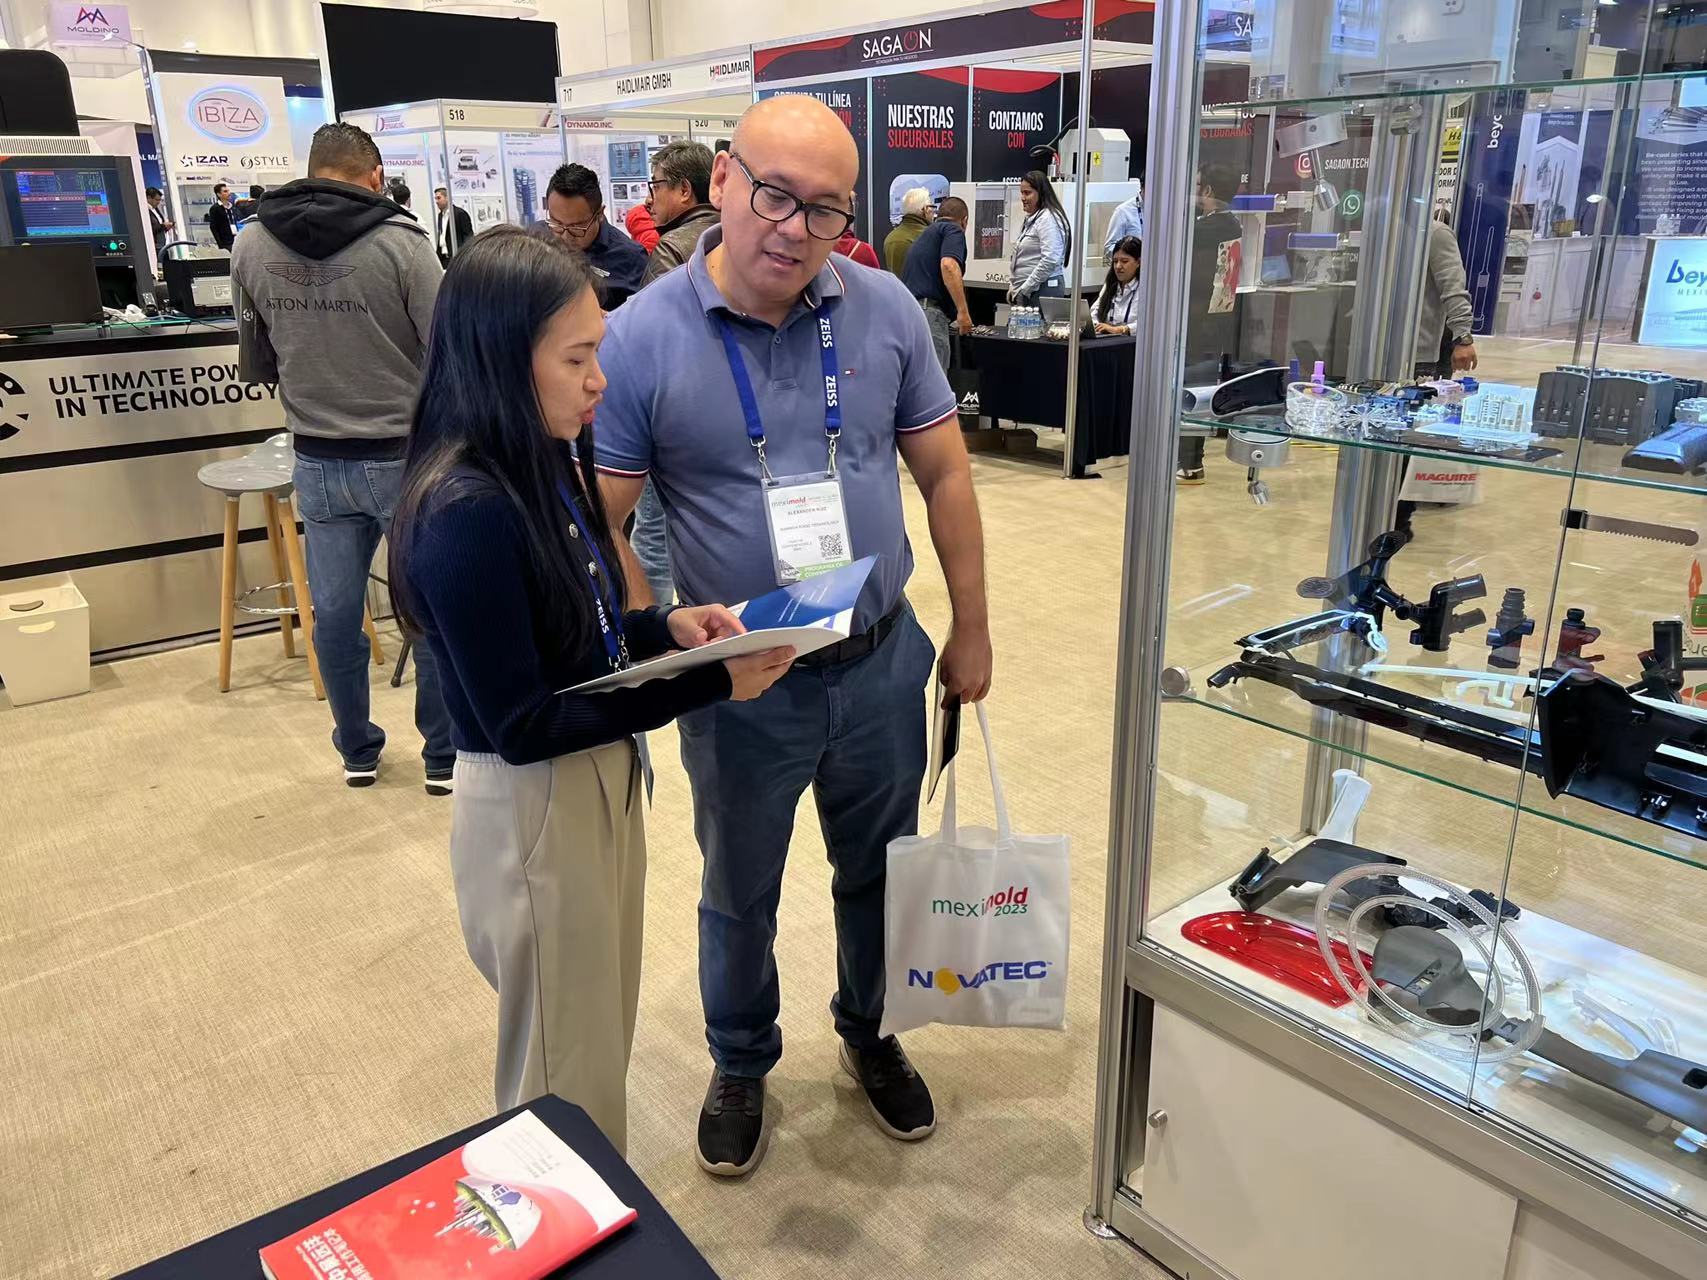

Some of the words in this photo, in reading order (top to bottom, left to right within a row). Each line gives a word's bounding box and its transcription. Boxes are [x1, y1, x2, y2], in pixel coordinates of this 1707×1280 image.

[67, 26, 120, 34] MOLDINO
[862, 28, 933, 59] SAGAON
[709, 60, 751, 77] HAIDLMAIR
[563, 89, 573, 103] 717
[616, 78, 650, 96] HAIDLMAIR
[652, 72, 672, 89] GMBH
[828, 89, 852, 107] LÍNEA
[198, 106, 260, 125] IBIZA
[449, 109, 465, 121] 518
[695, 119, 709, 128] 520
[887, 104, 954, 129] NUESTRAS
[989, 110, 1044, 131] CONTAMOS
[887, 129, 954, 149] SUCURSALES
[1007, 131, 1025, 149] CON
[196, 155, 229, 164] IZAR
[254, 156, 289, 166] STYLE
[1324, 157, 1369, 170] SAGAON.TECH
[265, 297, 308, 311] ASTON
[314, 299, 369, 315] MARTIN
[819, 317, 833, 348] ZEISS
[48, 367, 184, 396] ULTIMATE
[825, 375, 838, 407] ZEISS
[54, 397, 86, 419] IN
[92, 383, 278, 415] TECHNOLOGY
[1414, 472, 1478, 482] MAGUIRE
[993, 903, 1029, 917] 2023
[302, 1235, 351, 1280] 中展远洋
